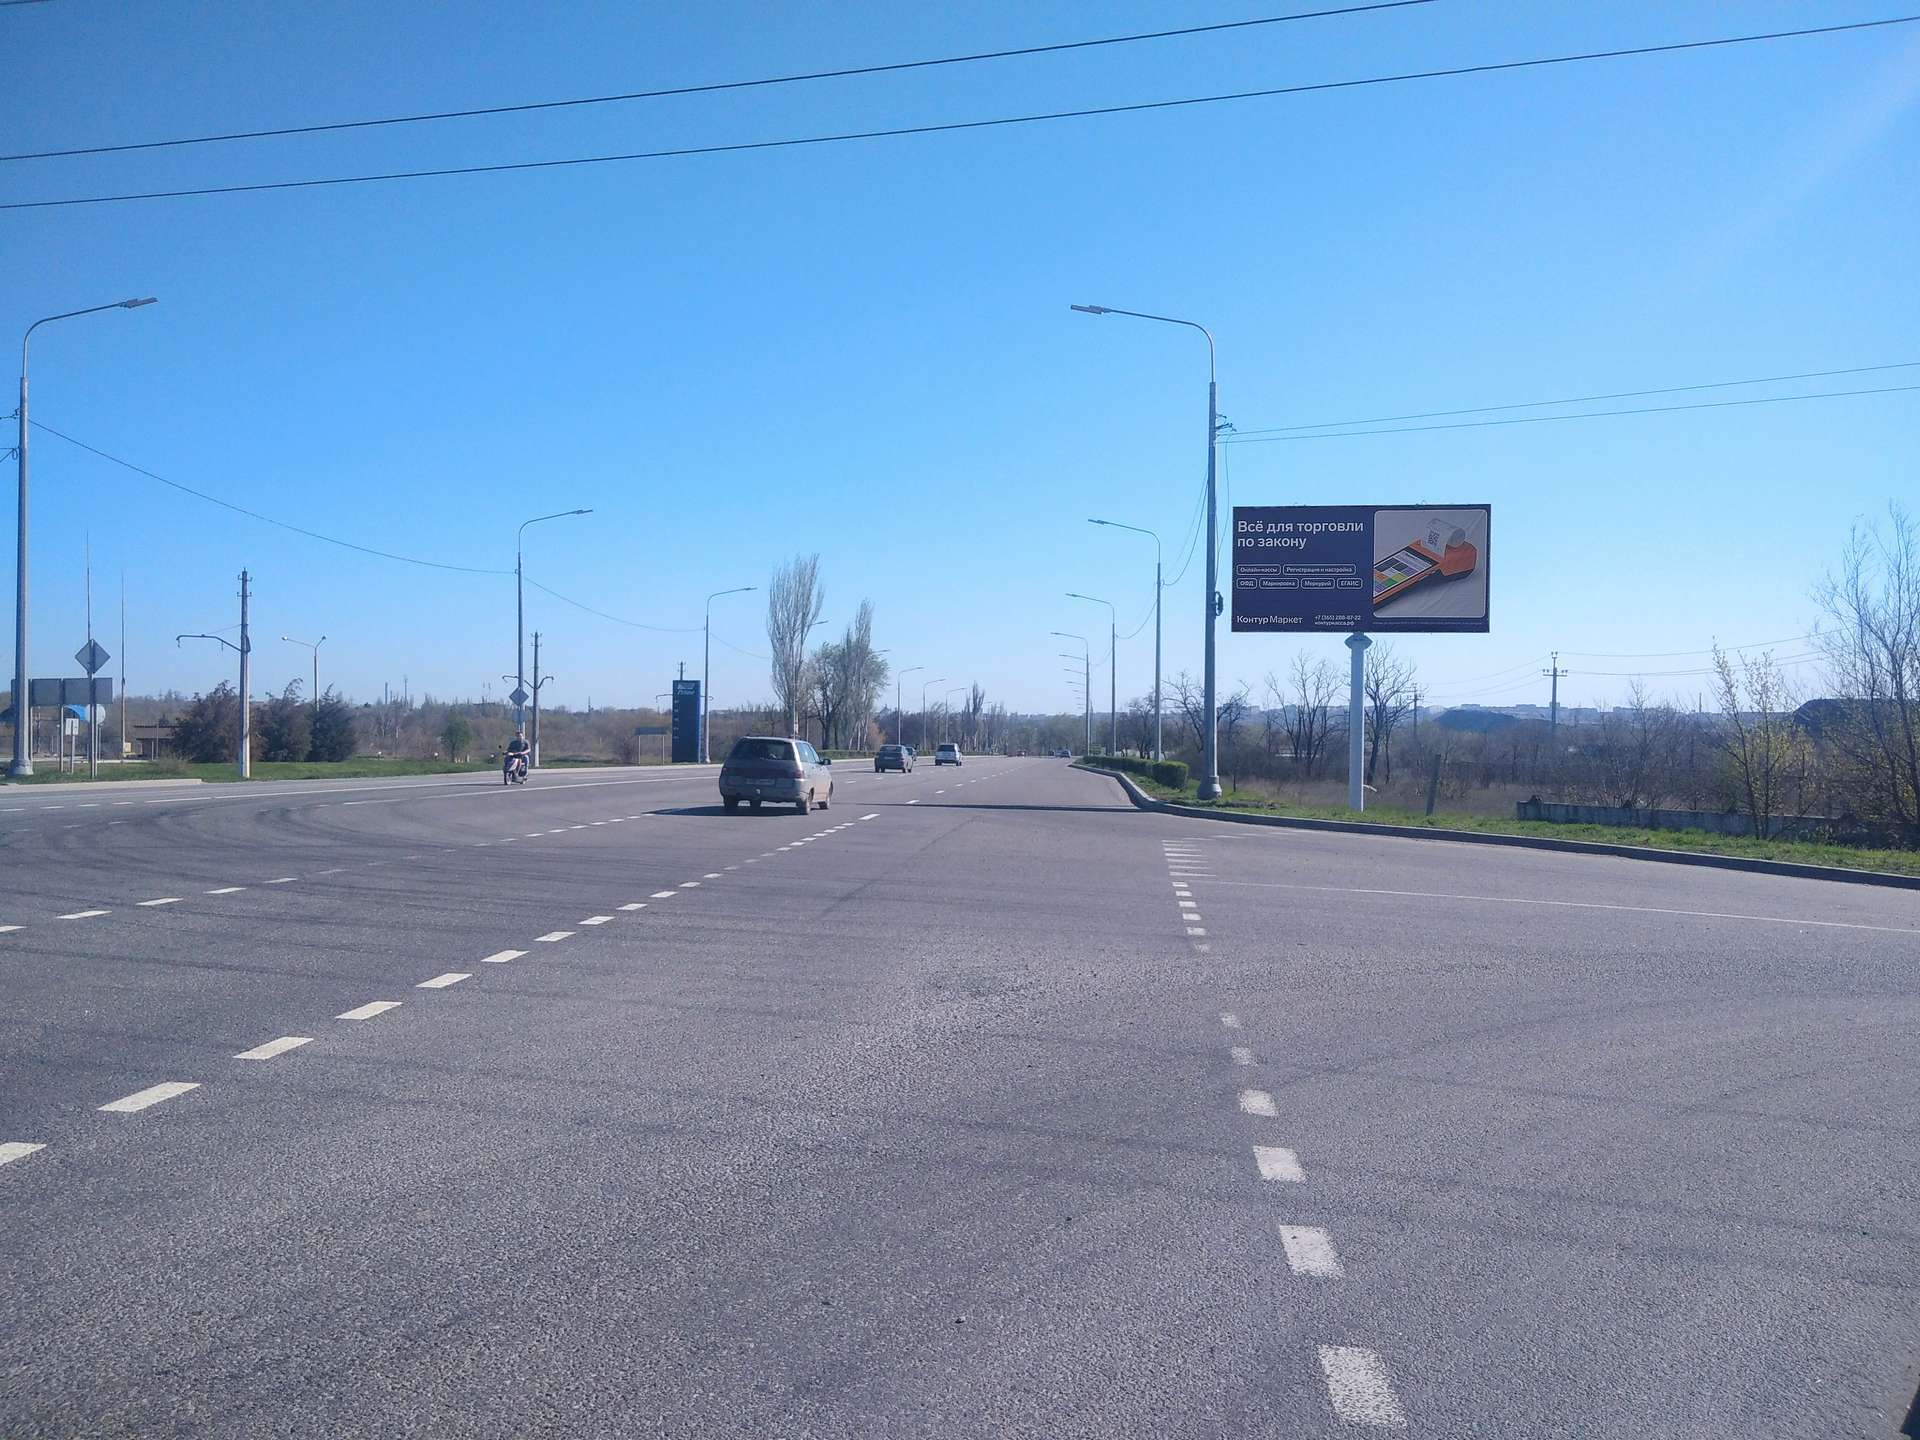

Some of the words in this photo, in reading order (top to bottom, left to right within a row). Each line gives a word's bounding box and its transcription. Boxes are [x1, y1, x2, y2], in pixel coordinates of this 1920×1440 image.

[1237, 520, 1264, 533] Всё
[1266, 522, 1293, 535] для
[1296, 521, 1364, 535] торговли
[1237, 538, 1255, 548] по
[1257, 537, 1307, 549] закону
[1286, 566, 1320, 574] Регистрация
